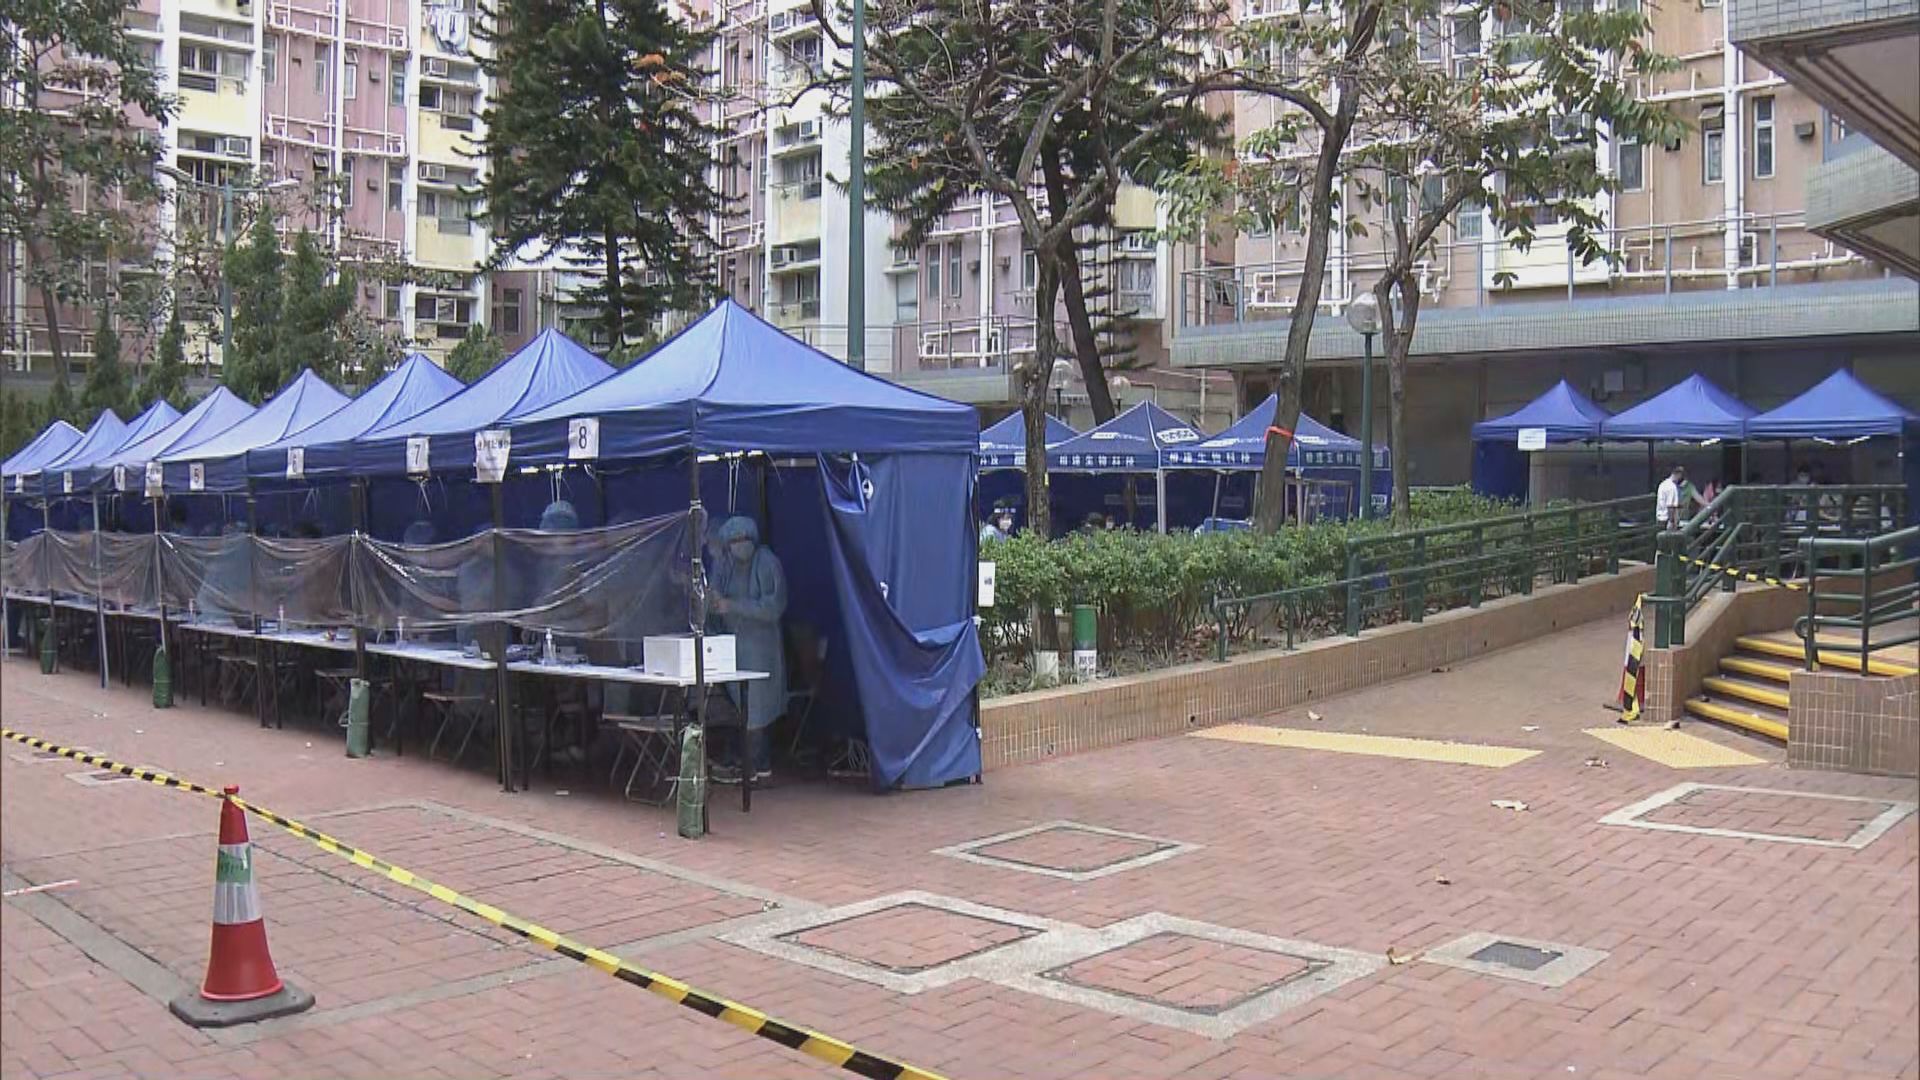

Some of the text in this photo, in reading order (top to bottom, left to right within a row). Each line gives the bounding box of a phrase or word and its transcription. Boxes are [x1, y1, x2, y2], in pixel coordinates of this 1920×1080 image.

[578, 425, 587, 449] 8
[414, 444, 421, 465] 7
[193, 468, 200, 484] 5
